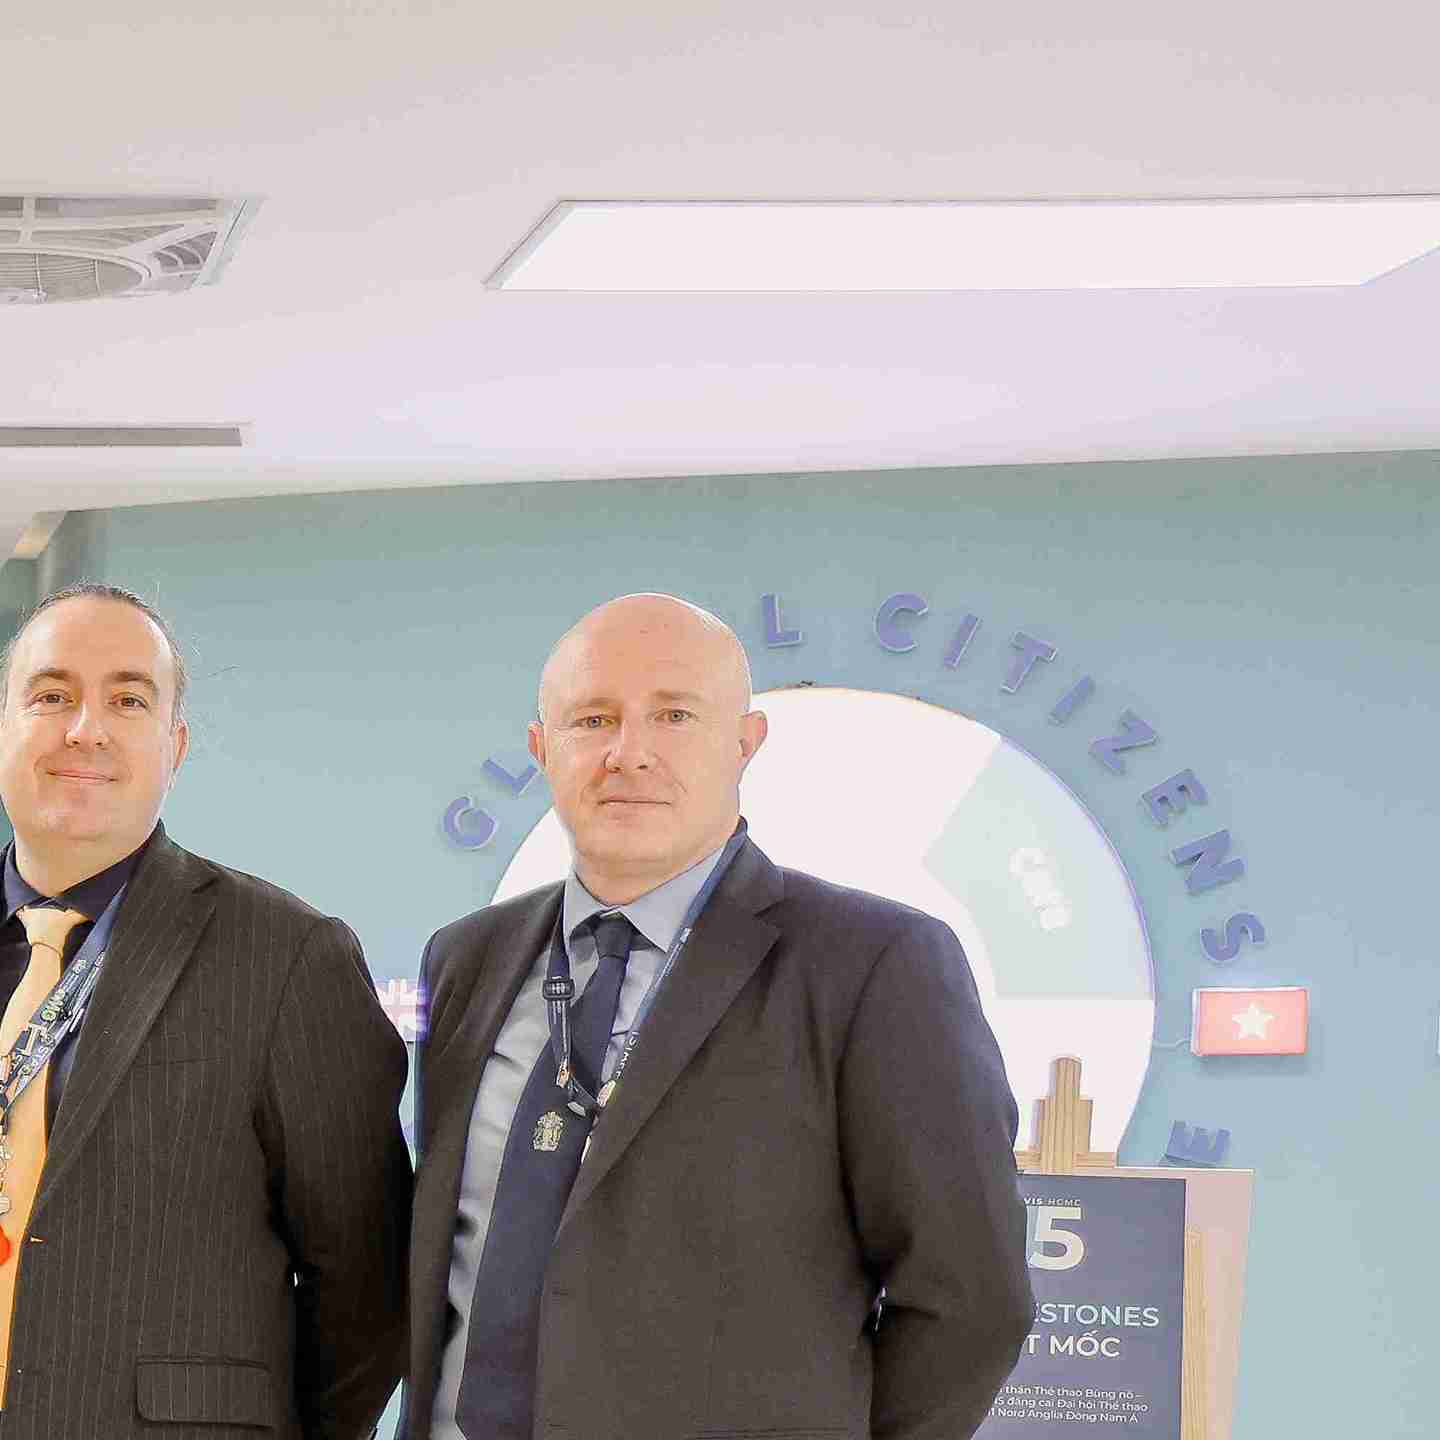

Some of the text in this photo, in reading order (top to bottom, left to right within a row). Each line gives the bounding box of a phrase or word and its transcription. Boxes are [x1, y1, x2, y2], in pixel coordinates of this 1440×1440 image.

[442, 593, 1267, 964] GLL CITIZENS
[1023, 1197, 1043, 1206] VIS
[1035, 1302, 1160, 1327] STONES
[1049, 1329, 1121, 1357] MỐC
[1027, 1408, 1064, 1421] Anglia
